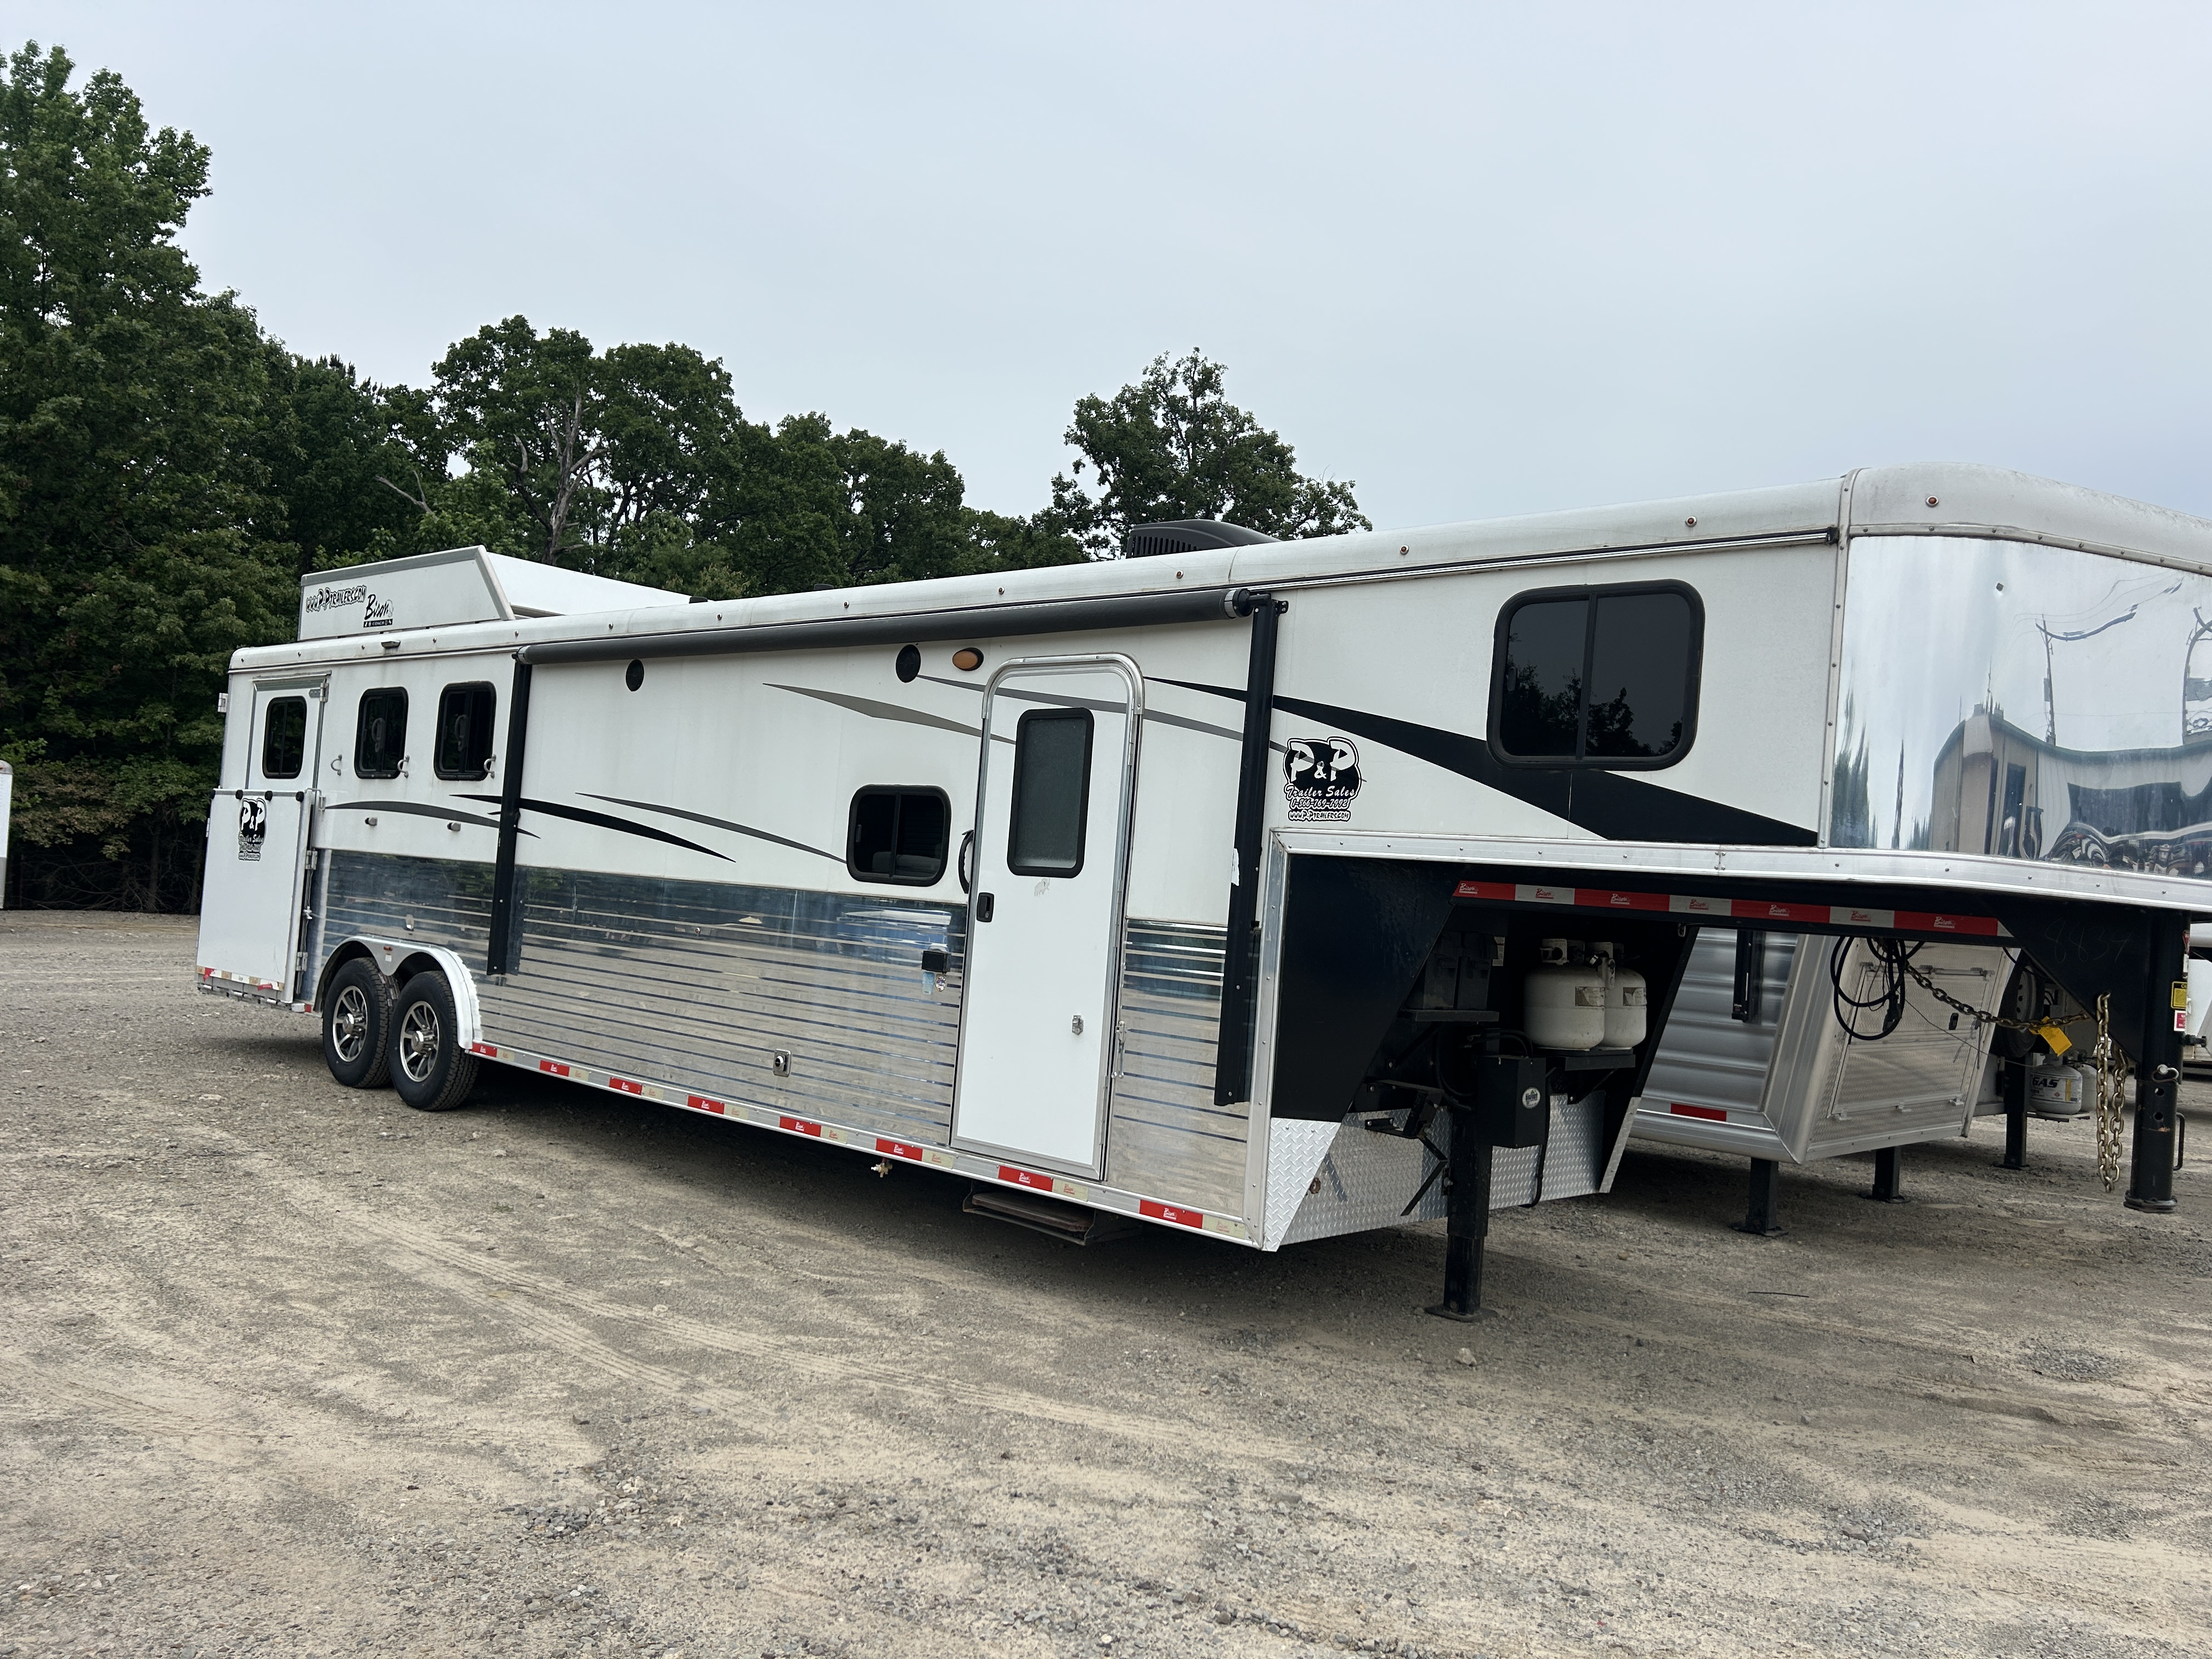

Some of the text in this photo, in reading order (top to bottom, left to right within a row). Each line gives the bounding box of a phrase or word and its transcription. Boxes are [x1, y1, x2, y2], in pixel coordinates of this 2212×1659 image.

[364, 594, 390, 620] Bison
[1285, 785, 1356, 797] Trailer Sales
[1292, 798, 1348, 808] 1-866-769-7992
[1459, 883, 1475, 891] Bison
[1536, 888, 1552, 896] Bison
[1611, 893, 1627, 901] Bison
[1689, 899, 1706, 907] Bison
[1769, 904, 1786, 913] Bison
[1851, 910, 1868, 918] Bison
[1934, 916, 1952, 925] Bison
[2032, 1076, 2059, 1088] GAS
